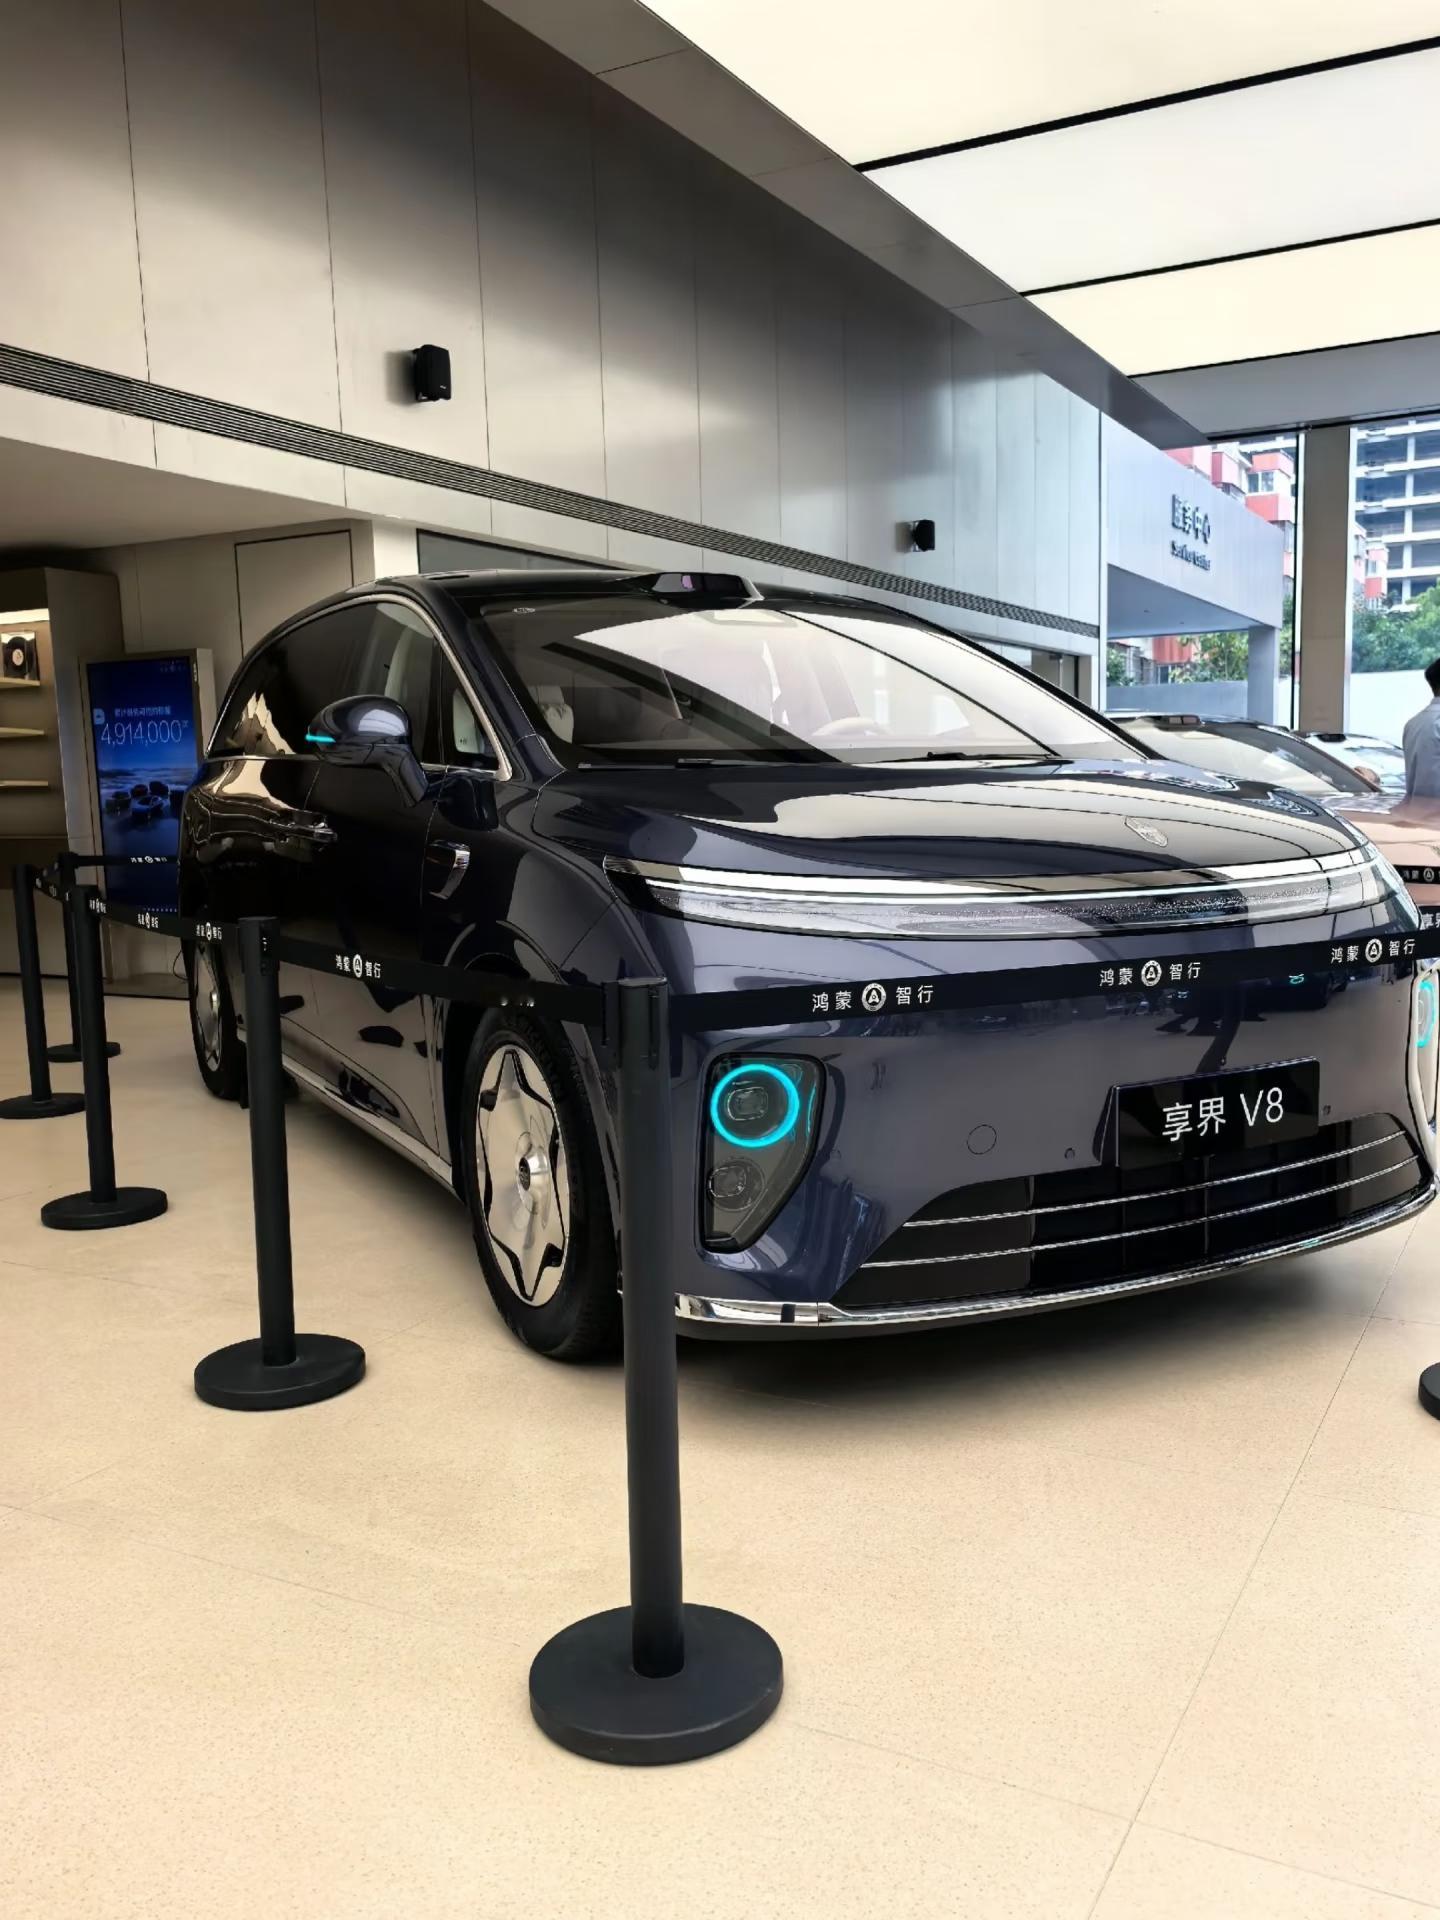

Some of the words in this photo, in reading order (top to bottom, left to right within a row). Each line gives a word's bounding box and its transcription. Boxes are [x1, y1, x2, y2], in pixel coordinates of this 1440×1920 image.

[101, 720, 182, 746] 4,914,000
[1331, 946, 1359, 963] 鸿蒙
[1389, 939, 1415, 956] 智行
[1099, 967, 1133, 987] 鸿蒙
[1169, 961, 1201, 981] 智行
[812, 990, 852, 1012] 鸿蒙
[895, 984, 934, 1005] 智行
[1162, 1096, 1226, 1141] 享界
[1240, 1087, 1284, 1126] V8
